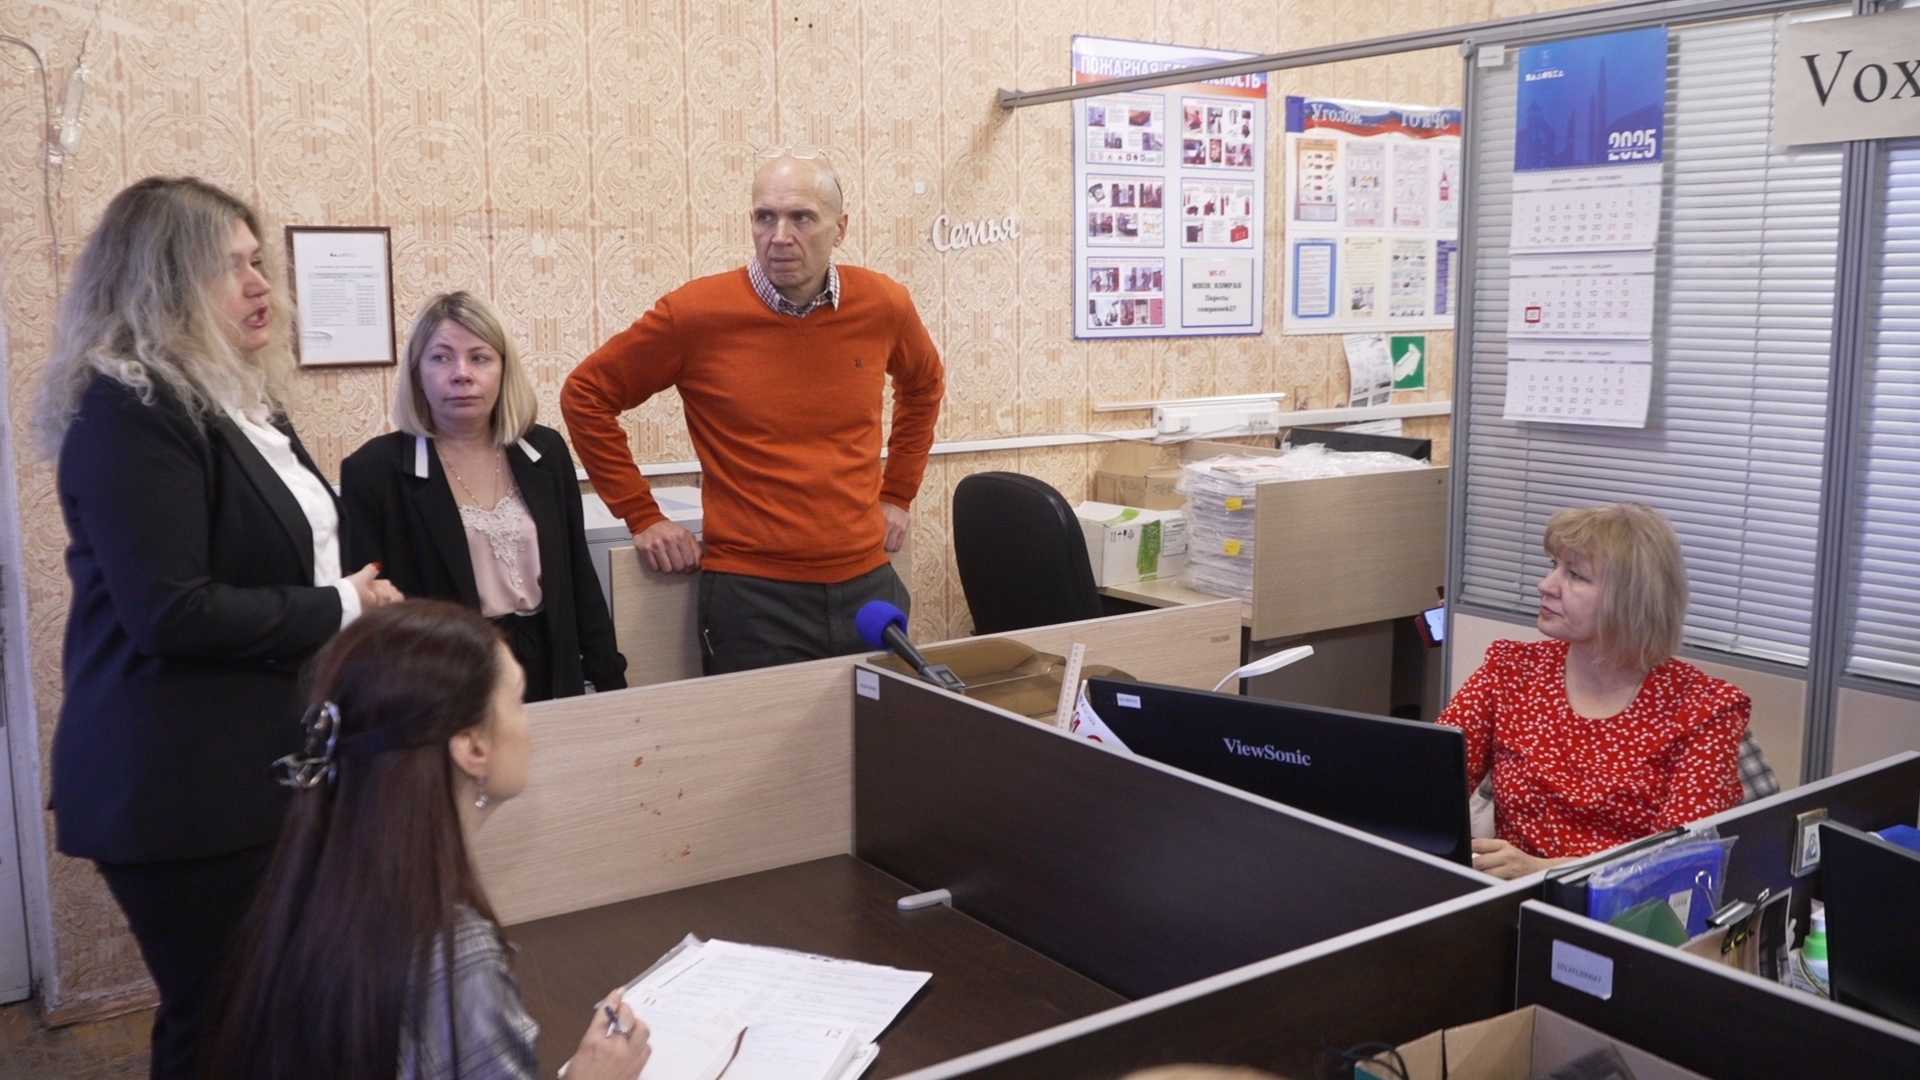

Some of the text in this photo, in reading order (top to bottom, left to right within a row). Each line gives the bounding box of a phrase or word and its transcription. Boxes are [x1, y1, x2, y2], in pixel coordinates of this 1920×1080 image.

[1081, 55, 1158, 78] ПОЖАРНАЯ
[1311, 103, 1363, 124] Уголок
[1608, 129, 1656, 161] 2025
[932, 213, 1020, 252] Семья
[1222, 737, 1312, 767] ViewSonic
